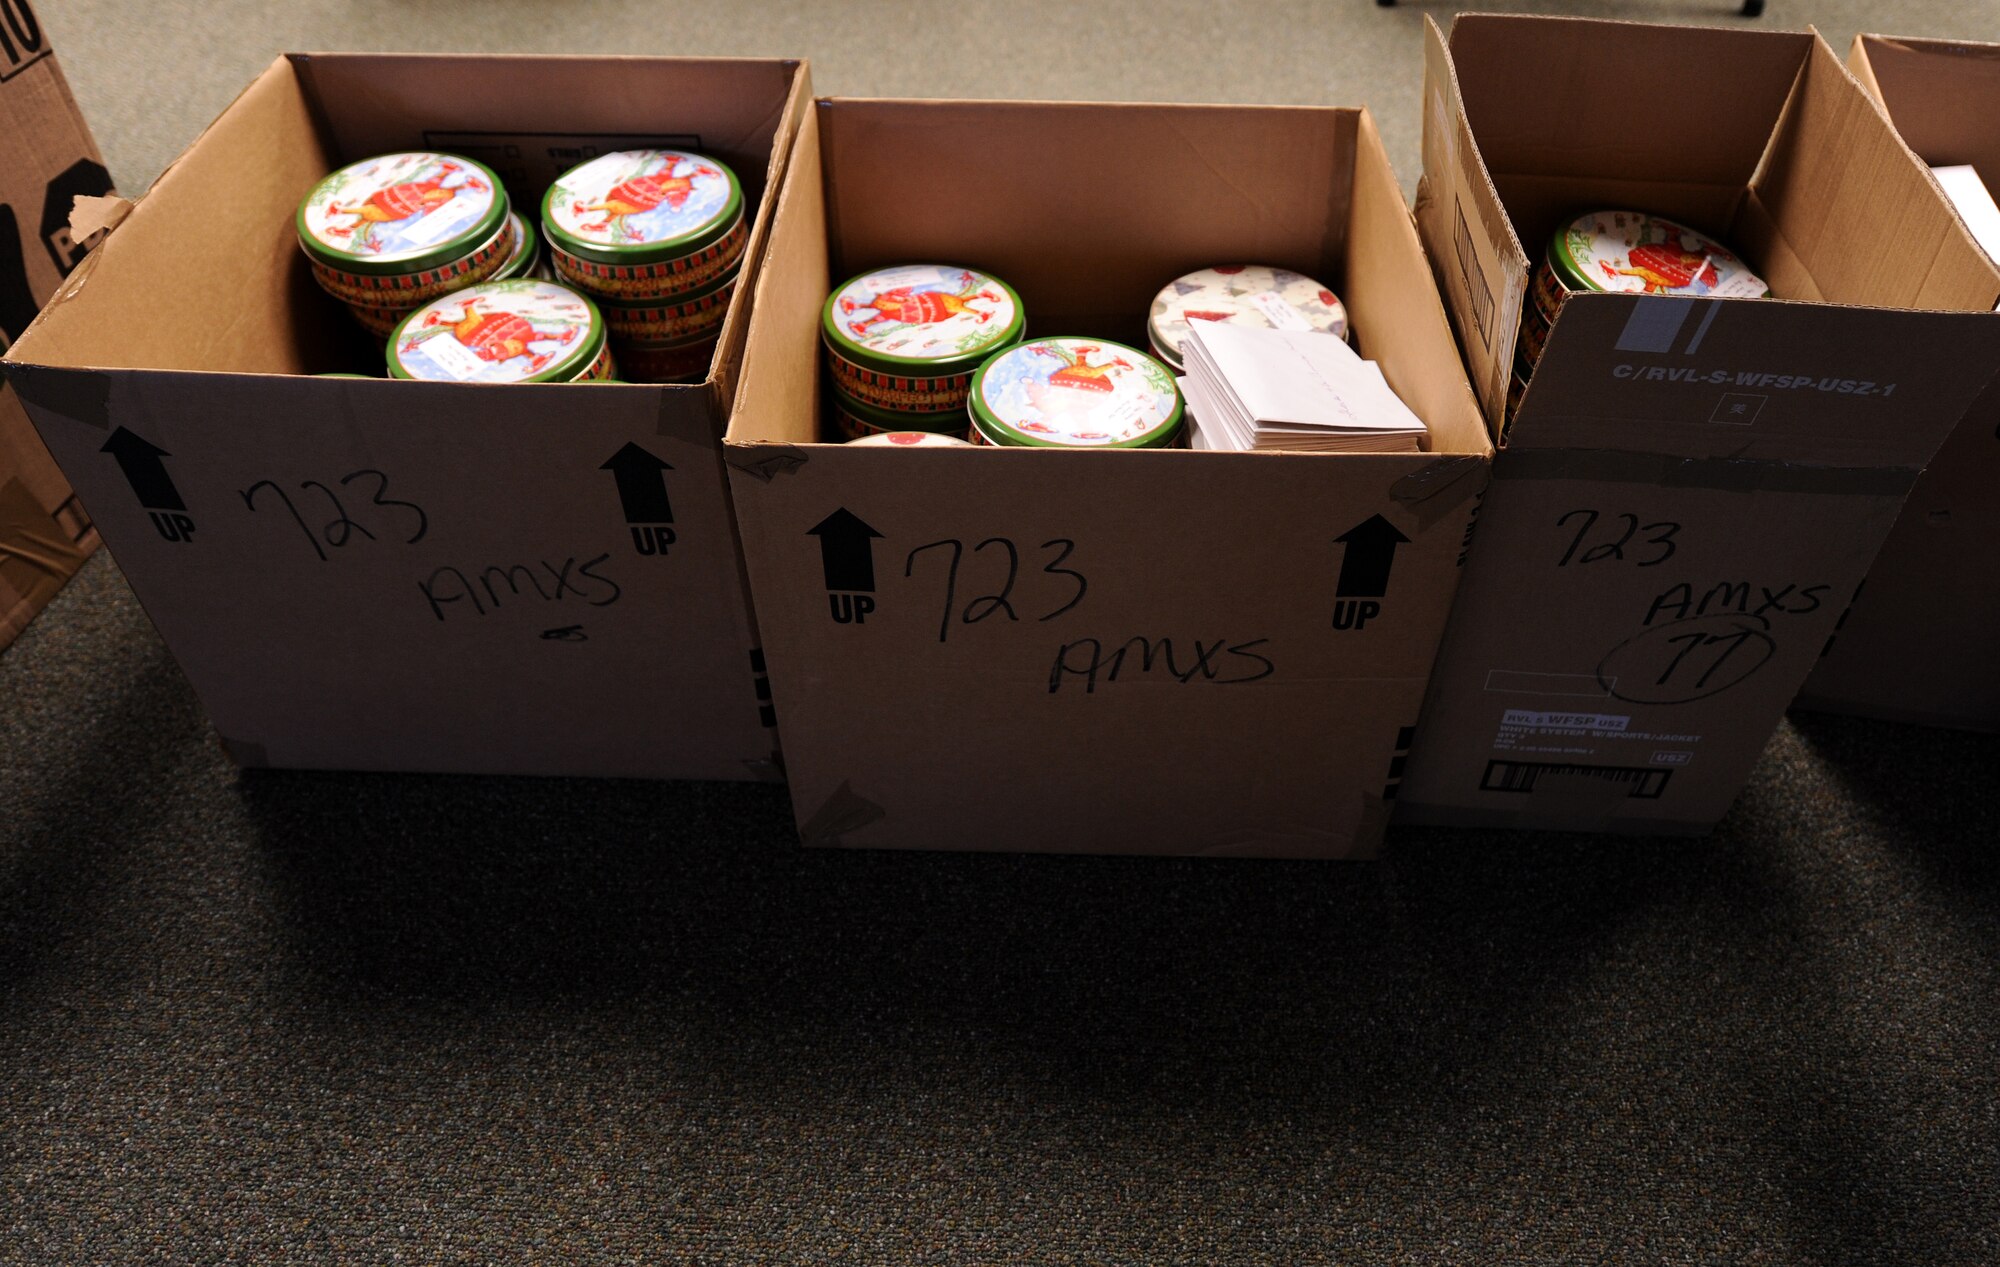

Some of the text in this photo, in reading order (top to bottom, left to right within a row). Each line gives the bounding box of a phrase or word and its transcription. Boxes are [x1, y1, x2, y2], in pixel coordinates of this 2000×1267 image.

[1612, 364, 1897, 396] C/RVL-S-WFSP-USZ-1
[147, 510, 196, 543] UP
[238, 470, 427, 561] 723
[629, 526, 677, 556] UP
[1557, 510, 1682, 566] 723
[418, 553, 620, 622] AMXS
[905, 538, 1088, 643] 723
[1643, 582, 1831, 626] AMXS
[828, 593, 876, 625] UP
[1331, 600, 1381, 631] UP
[1049, 637, 1274, 694] AMXS
[1656, 632, 1751, 688] 77
[1548, 715, 1596, 725] WFSP
[1656, 753, 1688, 763] USZ
